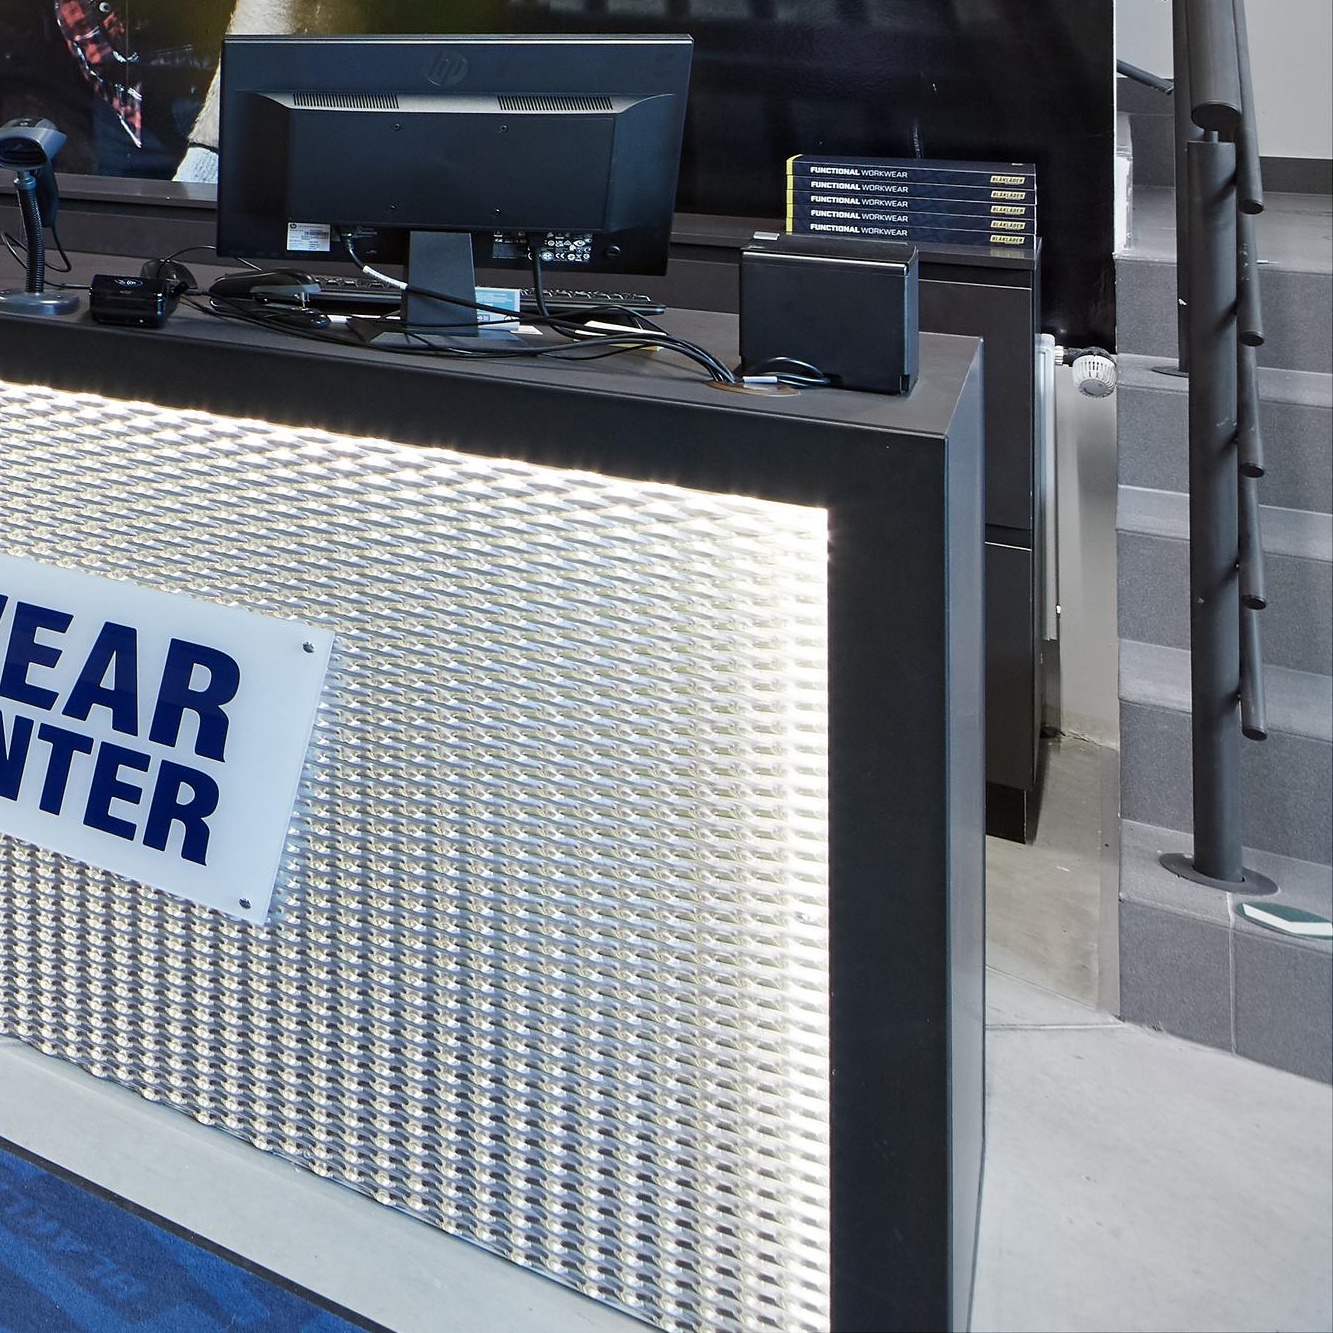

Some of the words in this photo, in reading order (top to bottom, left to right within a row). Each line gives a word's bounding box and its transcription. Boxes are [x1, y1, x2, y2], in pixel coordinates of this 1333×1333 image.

[810, 166, 861, 176] FUNCTIONAL
[861, 169, 909, 179] WORKWEAR
[810, 181, 861, 191] FUNCTIONAL
[861, 184, 909, 194] WORKWEAR
[810, 195, 861, 205] FUNCTIONAL
[861, 199, 909, 209] WORKWEAR
[810, 209, 861, 219] FUNCTIONAL
[861, 213, 909, 223] WORKWEAR
[810, 223, 861, 233] FUNCTIONAL
[861, 227, 909, 237] WORKWEAR
